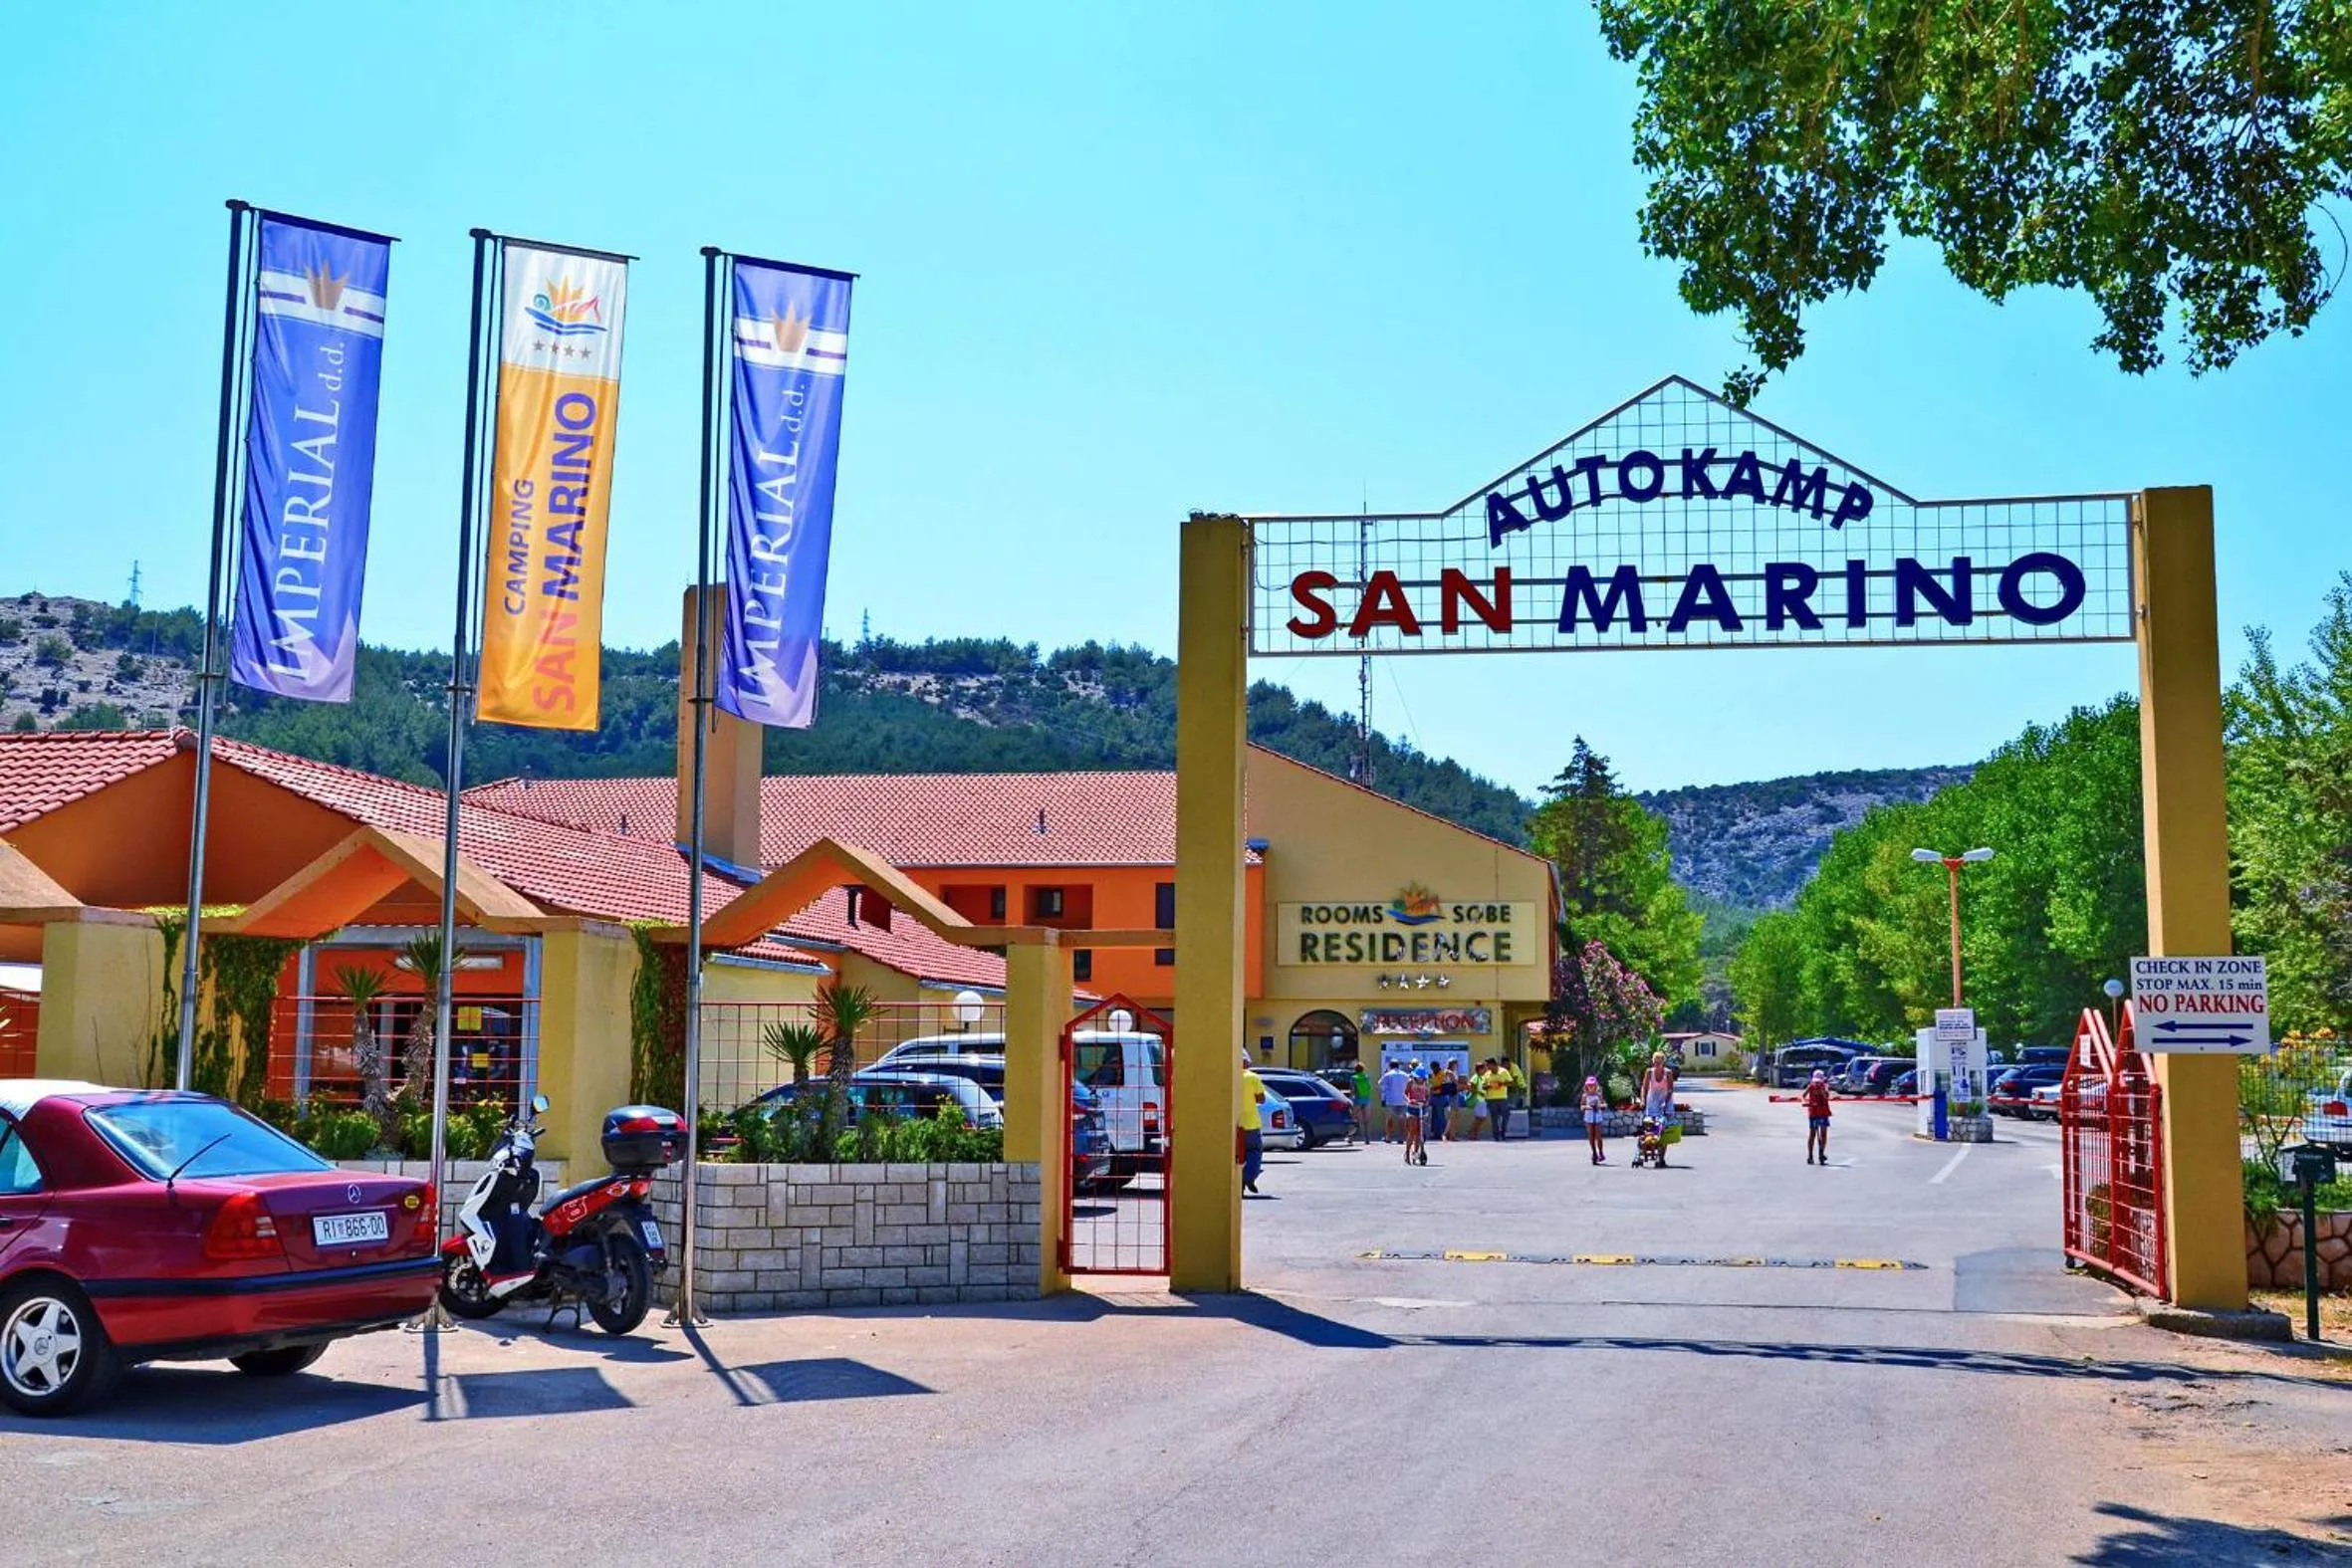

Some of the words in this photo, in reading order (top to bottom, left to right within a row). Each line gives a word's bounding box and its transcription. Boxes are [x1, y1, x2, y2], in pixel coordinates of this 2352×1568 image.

[267, 400, 341, 682] IMPERIAL
[317, 341, 346, 392] d.d.
[542, 392, 597, 601] MARINO
[1487, 447, 1875, 550] AUTOKAMP
[504, 478, 535, 617] CAMPING
[738, 442, 800, 708] IMPERIAL
[781, 383, 806, 434] d.d.
[1286, 565, 1513, 639] SAN
[1557, 552, 2086, 633] MARINO
[531, 609, 578, 714] SAN
[1300, 904, 1384, 925] ROOMS
[1452, 904, 1512, 924] SOBE
[1299, 931, 1513, 963] RESIDENCE
[2135, 960, 2191, 975] CHECK
[2195, 960, 2212, 975] IN
[2217, 960, 2262, 974] ZONE
[2136, 978, 2173, 991] STOP
[2177, 978, 2216, 991] MAX.
[2219, 979, 2234, 991] 15
[2237, 978, 2263, 991] min
[2138, 993, 2169, 1013] NO
[2174, 993, 2264, 1013] PARKING
[323, 1221, 337, 1239] RI
